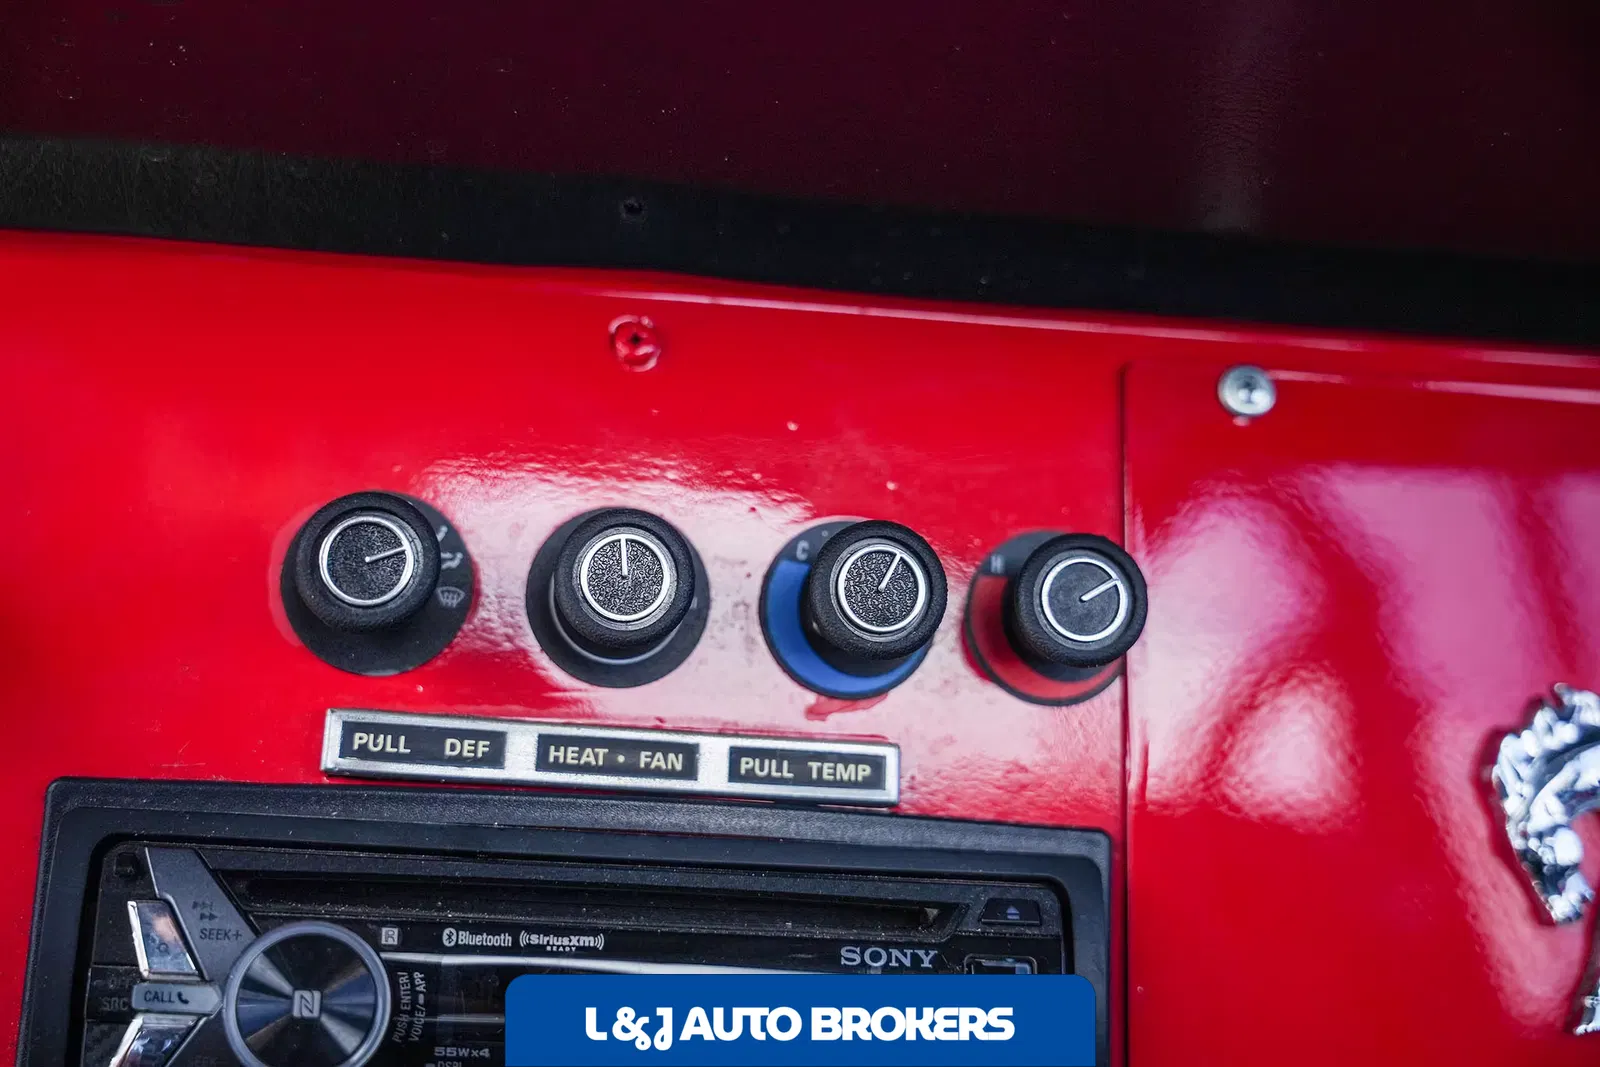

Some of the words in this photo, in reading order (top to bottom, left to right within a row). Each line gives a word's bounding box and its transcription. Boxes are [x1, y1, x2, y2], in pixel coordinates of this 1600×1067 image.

[795, 539, 810, 561] C
[353, 732, 412, 754] PULL
[444, 737, 491, 759] DEF
[548, 744, 609, 767] HEAT
[639, 750, 684, 772] FAN
[739, 756, 795, 779] PULL
[807, 761, 872, 783] TEMP
[199, 927, 243, 942] SEEK+
[457, 930, 513, 947] Bluetooth
[840, 946, 938, 969] SONY
[143, 990, 175, 1004] CALL
[392, 1013, 410, 1043] PUSH
